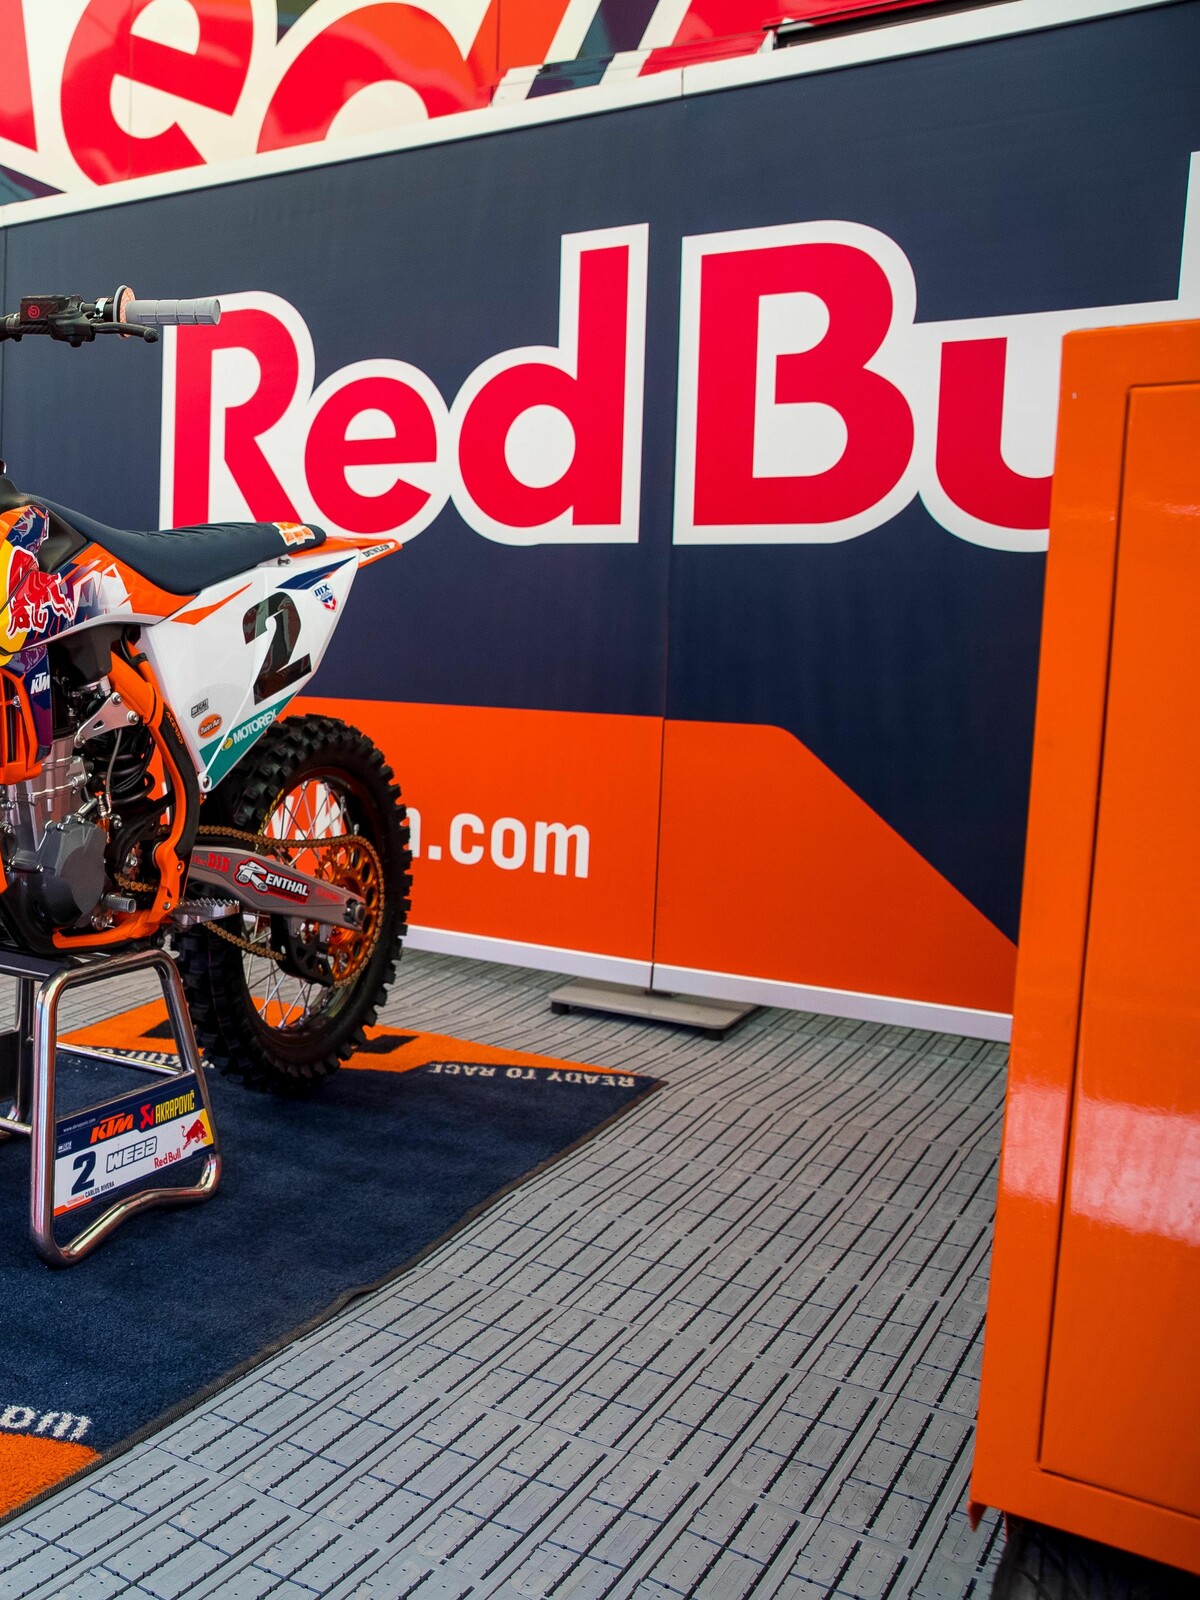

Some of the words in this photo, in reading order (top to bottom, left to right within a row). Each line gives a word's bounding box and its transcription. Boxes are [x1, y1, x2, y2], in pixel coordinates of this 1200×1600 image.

[172, 245, 630, 535] Red
[692, 241, 1055, 531] Bu
[242, 591, 312, 706] 2
[30, 672, 50, 695] KTM
[232, 708, 277, 745] MOTOREX
[428, 1063, 496, 1077] RACE
[505, 1067, 537, 1081] TO
[546, 1071, 636, 1088] READY
[90, 1112, 134, 1145] KTM
[71, 1151, 97, 1196] 2
[154, 1154, 168, 1169] Red
[168, 1148, 182, 1164] Bull
[85, 1187, 100, 1199] CARLOS
[101, 1181, 115, 1193] RIVERA
